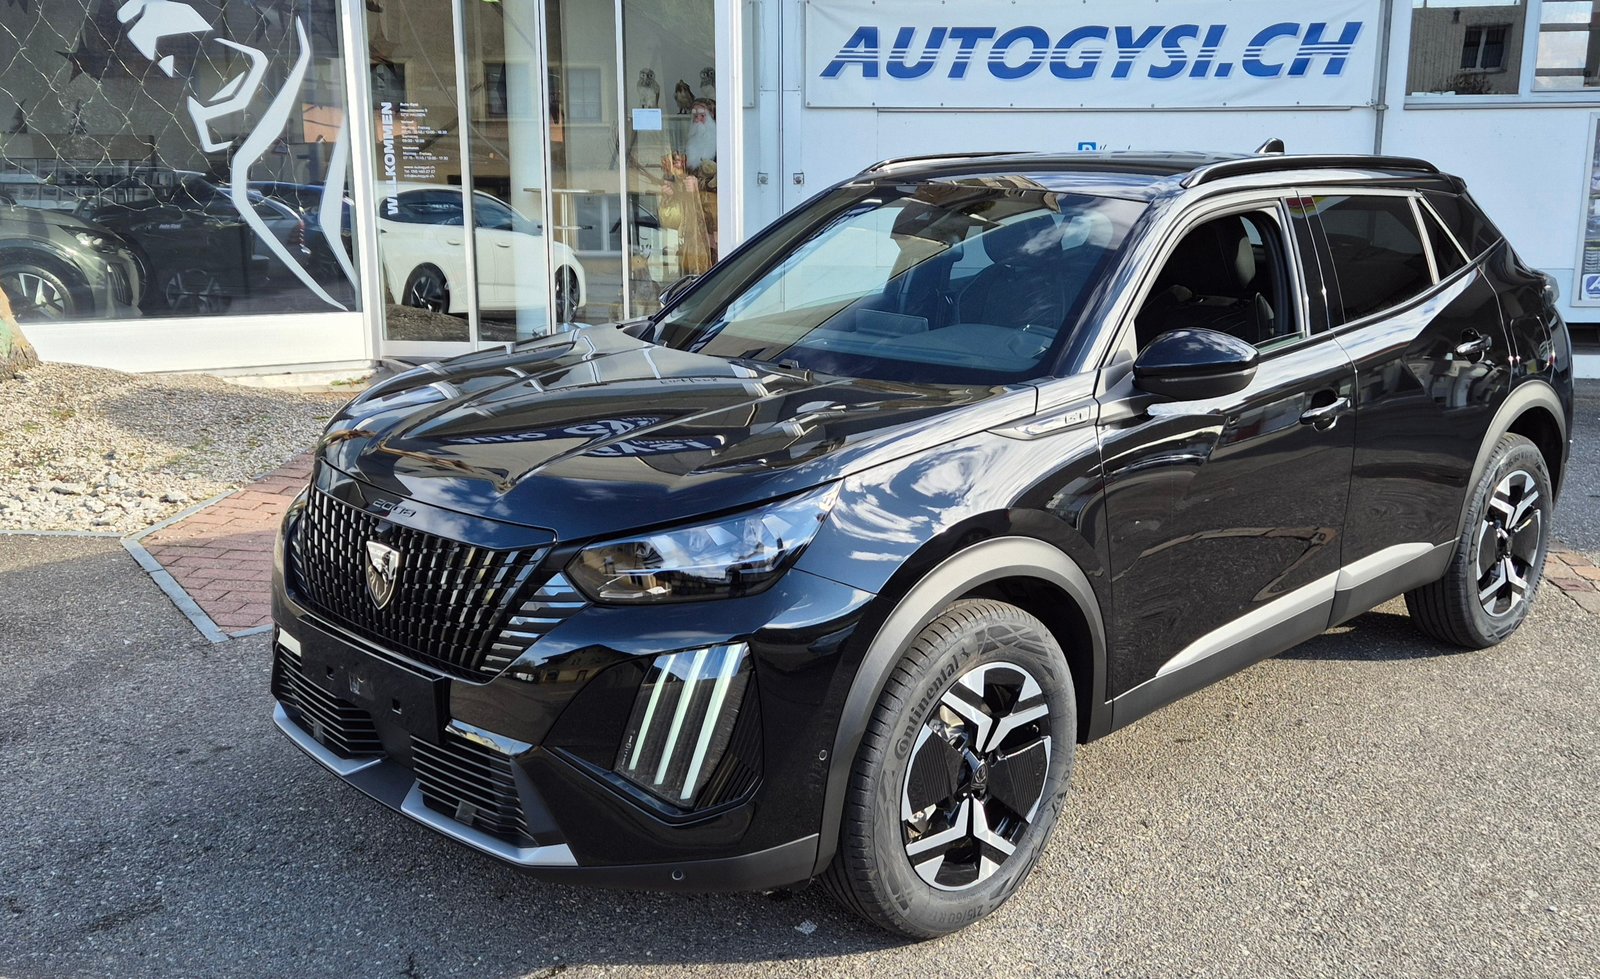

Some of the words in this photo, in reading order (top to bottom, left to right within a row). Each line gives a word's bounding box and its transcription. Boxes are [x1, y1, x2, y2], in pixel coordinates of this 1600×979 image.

[819, 22, 1363, 80] AUTOGYSI.CH
[381, 102, 399, 216] WILLKOMMEN
[373, 498, 417, 518] 2008
[895, 659, 960, 761] Continental
